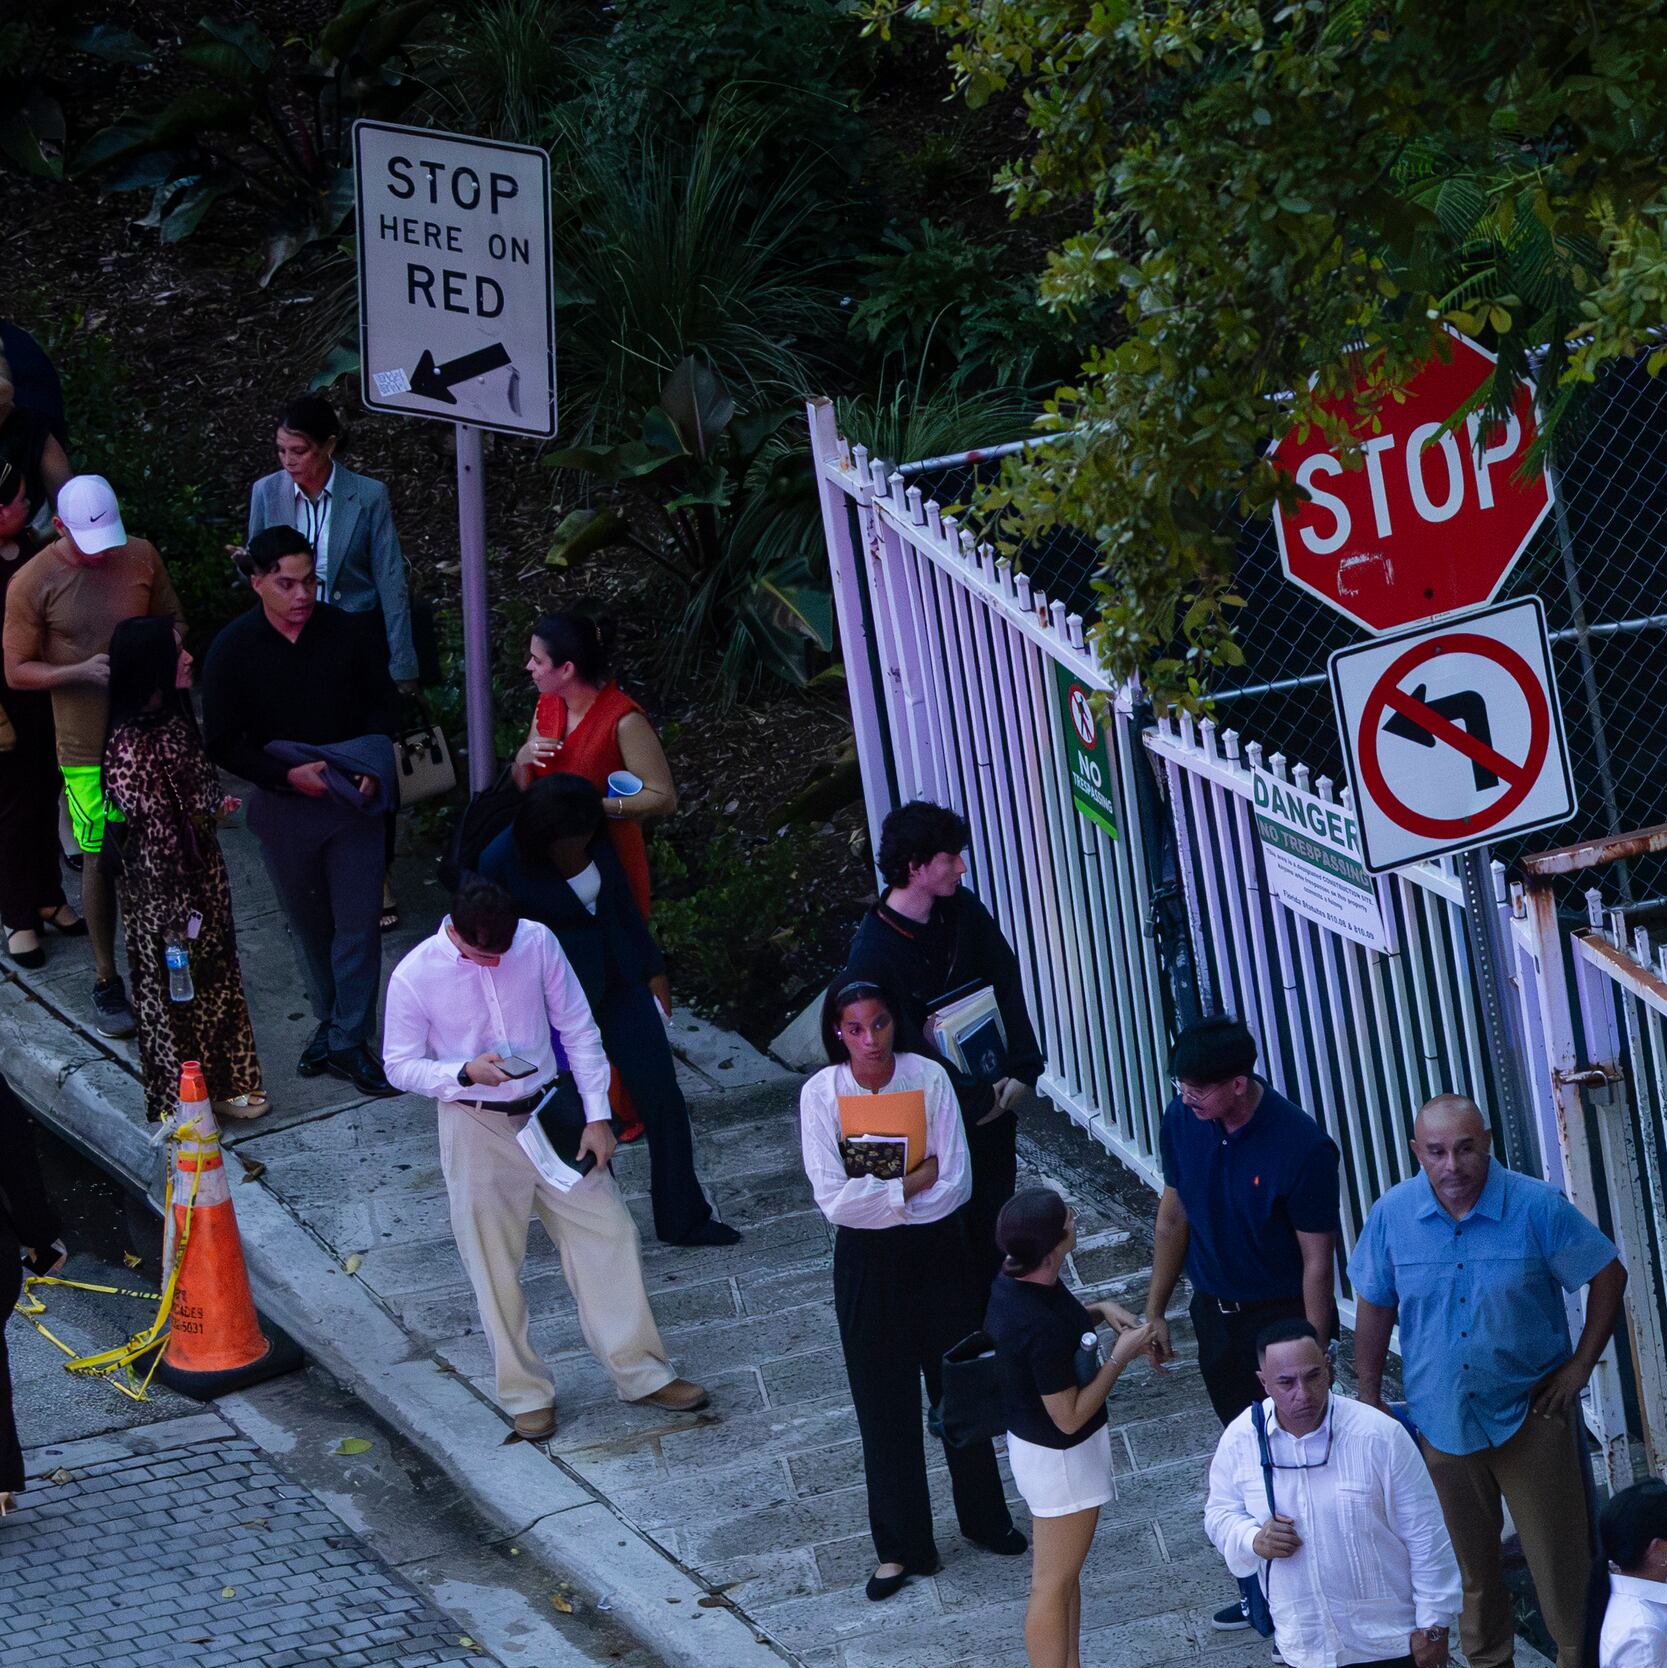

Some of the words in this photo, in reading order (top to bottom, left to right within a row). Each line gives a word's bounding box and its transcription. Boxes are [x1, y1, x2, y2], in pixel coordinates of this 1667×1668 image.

[387, 156, 519, 214] STOP
[380, 214, 463, 253] HERE
[488, 233, 529, 265] ON
[407, 262, 504, 319] RED
[1295, 405, 1521, 555] STOP
[1072, 770, 1113, 814] TRESPASSING
[1078, 750, 1102, 788] NO
[1254, 773, 1360, 853] DANGER
[1260, 819, 1279, 841] NO
[1280, 830, 1369, 886] TRESPASSING
[1283, 889, 1301, 905] Florida
[1303, 900, 1326, 918] Statutes
